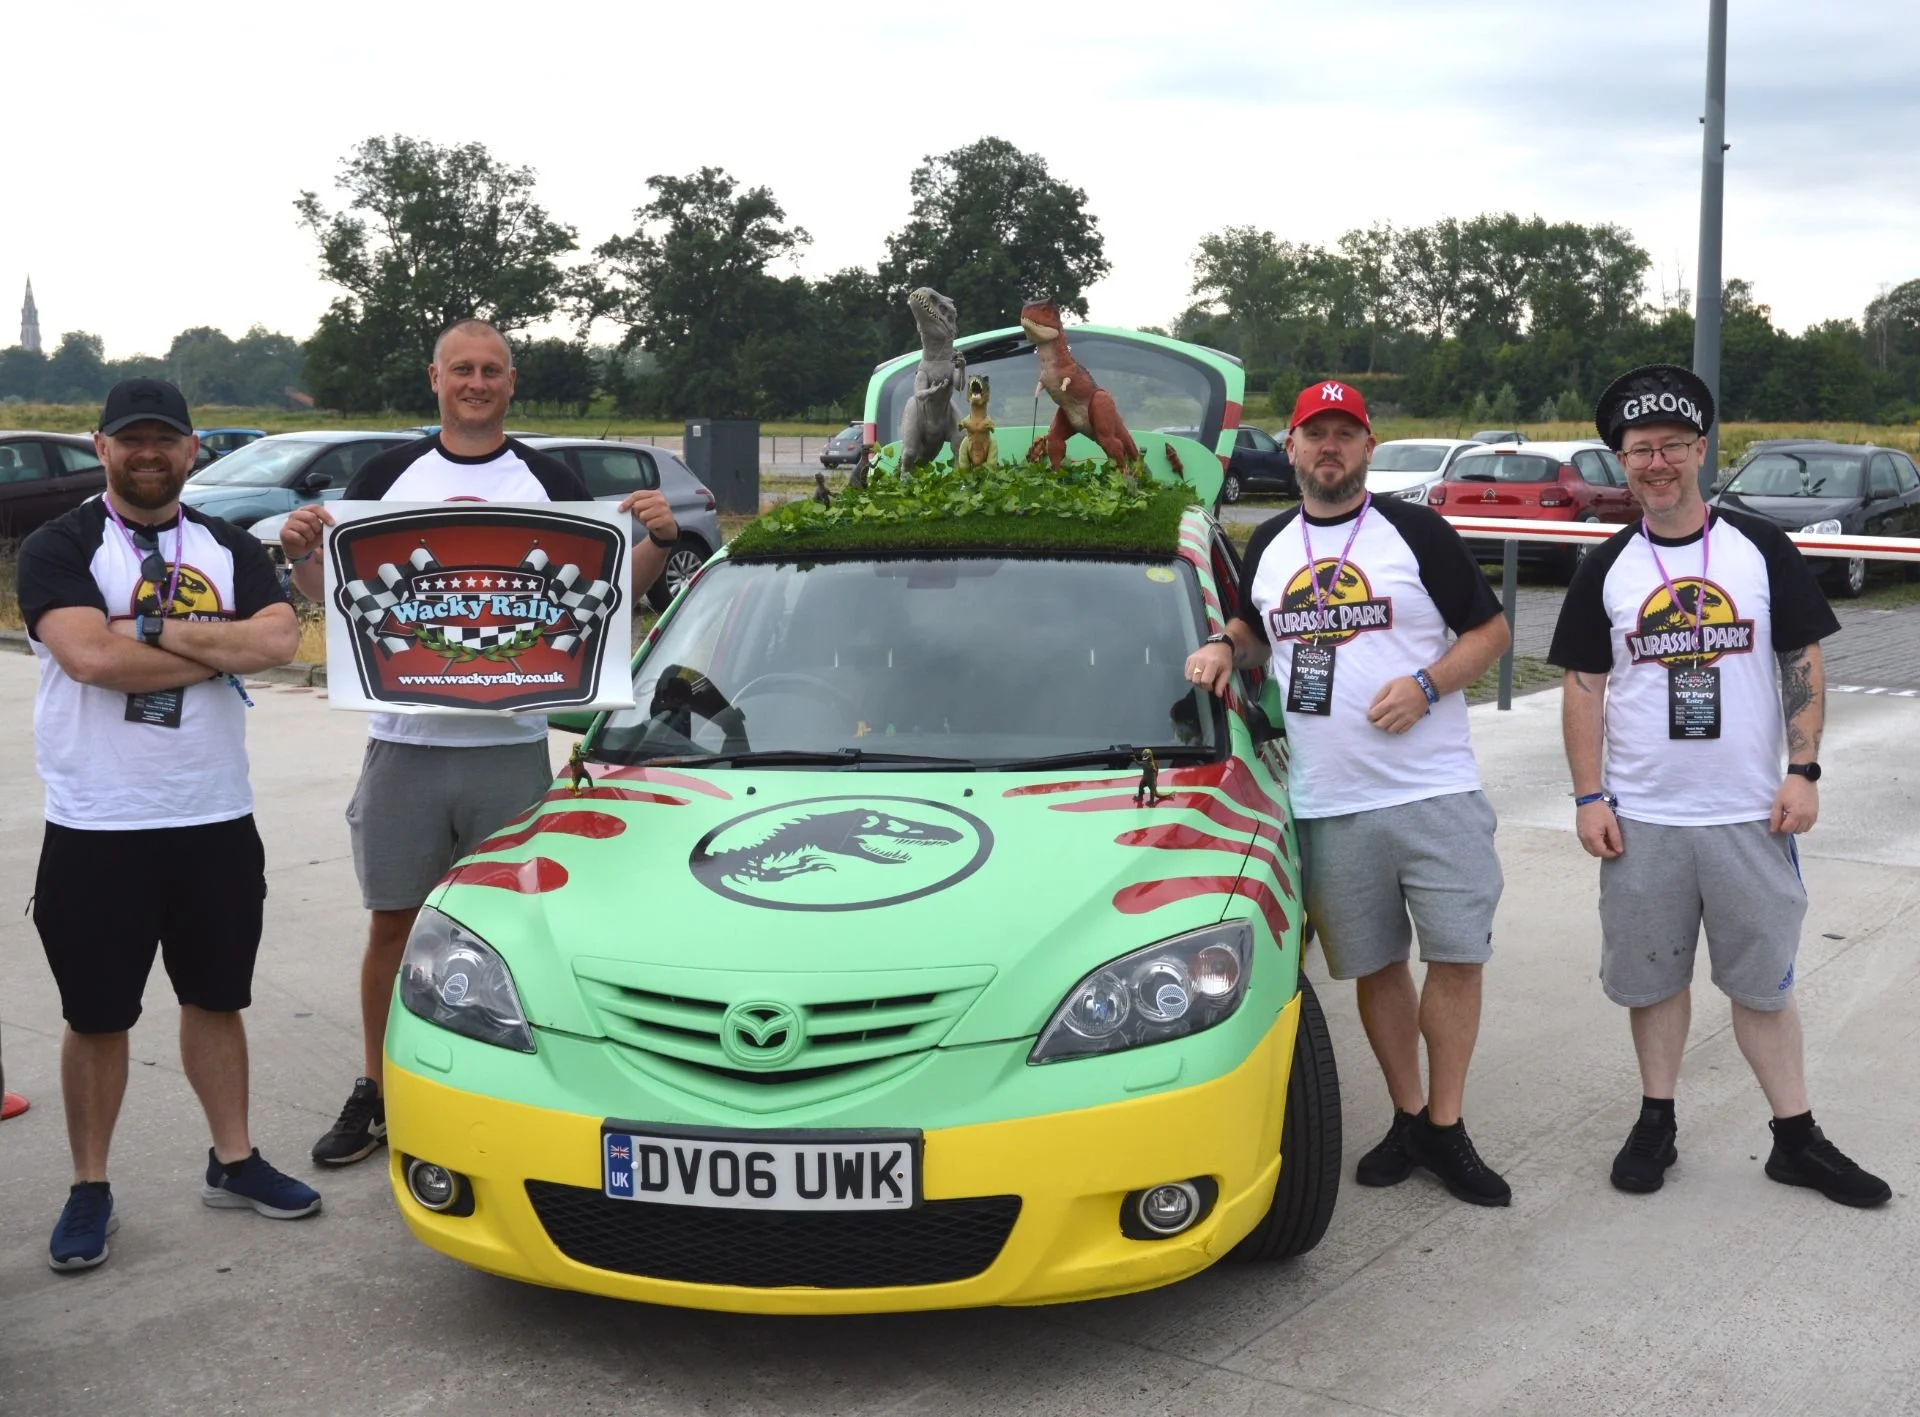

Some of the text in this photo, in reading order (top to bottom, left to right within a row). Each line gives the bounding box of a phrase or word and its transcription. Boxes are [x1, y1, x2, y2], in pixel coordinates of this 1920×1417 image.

[1623, 392, 1703, 430] GROOM
[390, 595, 566, 625] Wacky Rally
[1339, 604, 1388, 630] PARK
[1703, 626, 1750, 652] PARK
[398, 672, 565, 686] www.wackyrally.co.uk
[1296, 666, 1329, 677] VIP Party
[1675, 691, 1714, 700] VIP Party
[611, 1171, 629, 1188] UK
[795, 1150, 903, 1199] UWK
